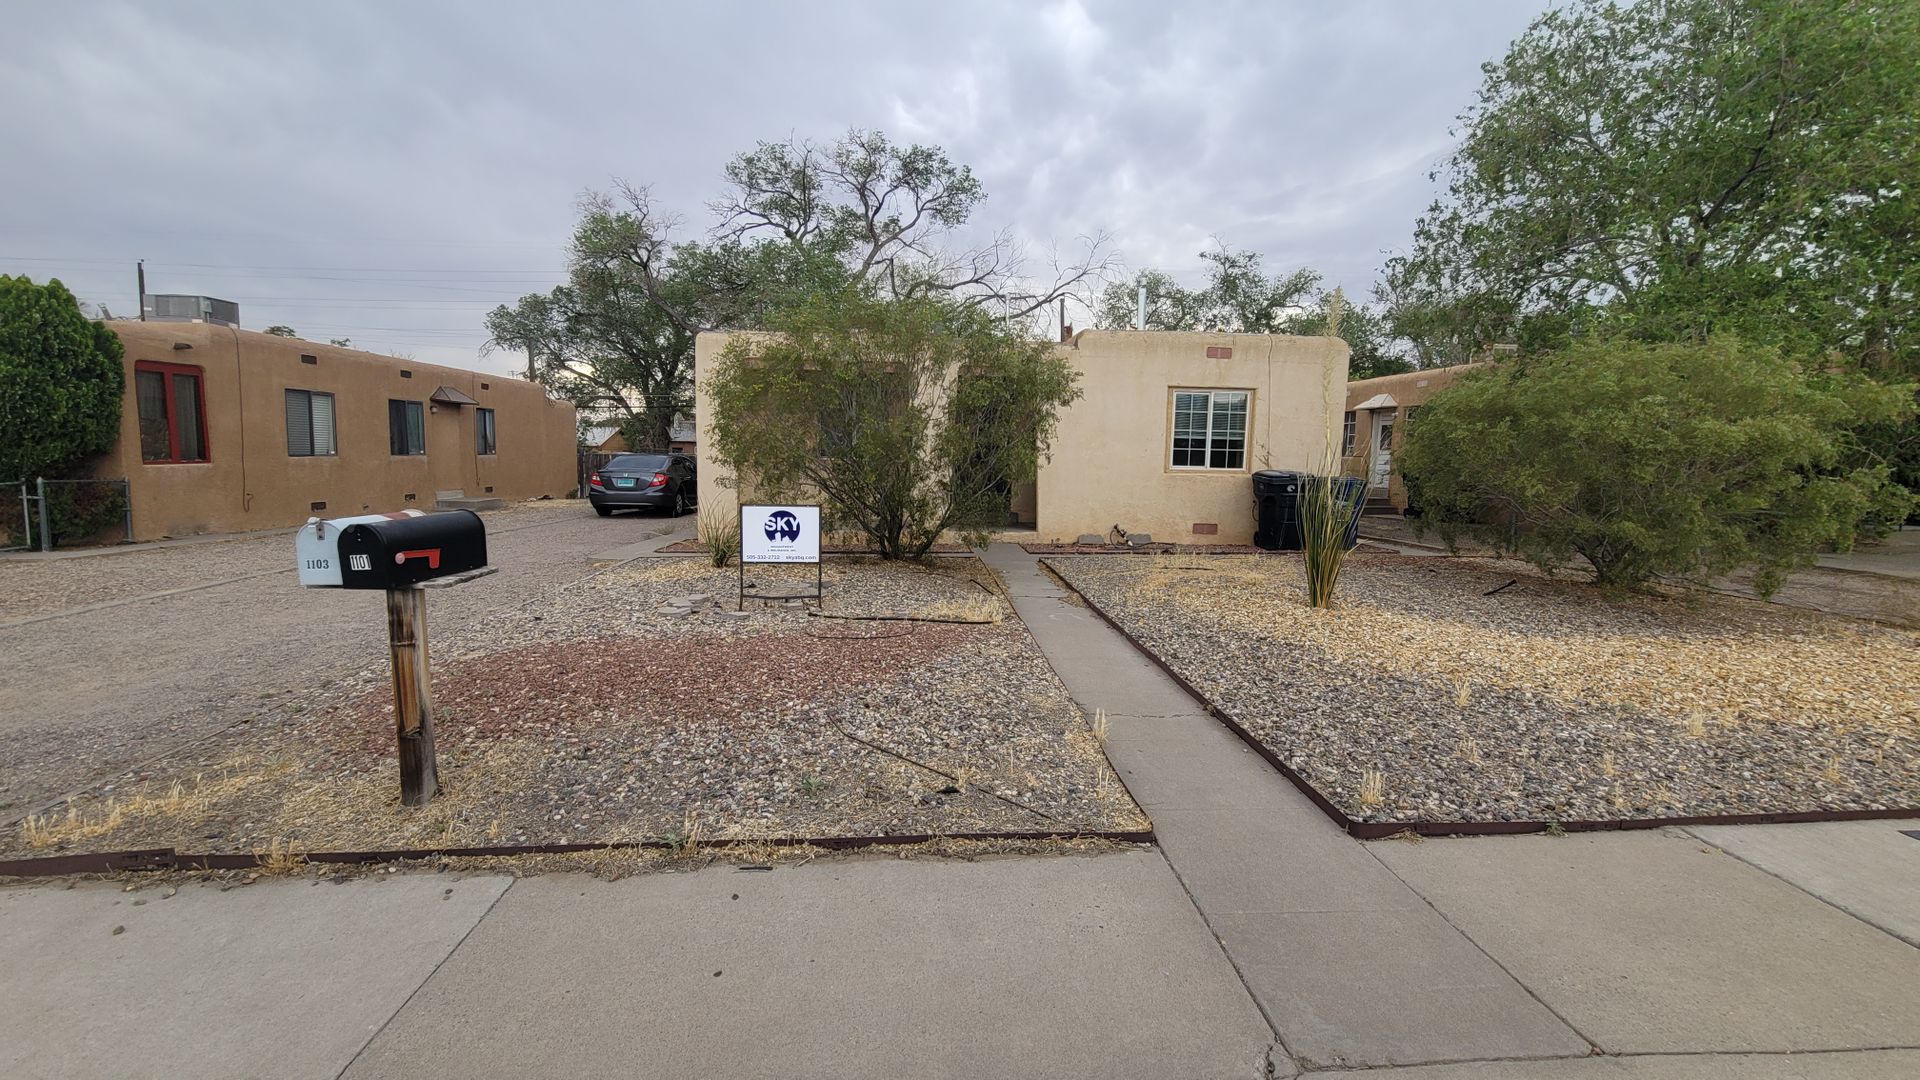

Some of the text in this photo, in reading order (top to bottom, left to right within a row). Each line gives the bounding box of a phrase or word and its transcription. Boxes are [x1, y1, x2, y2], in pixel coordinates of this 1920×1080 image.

[765, 516, 799, 531] SKY
[306, 559, 329, 569] 1103
[350, 555, 371, 569] 1101
